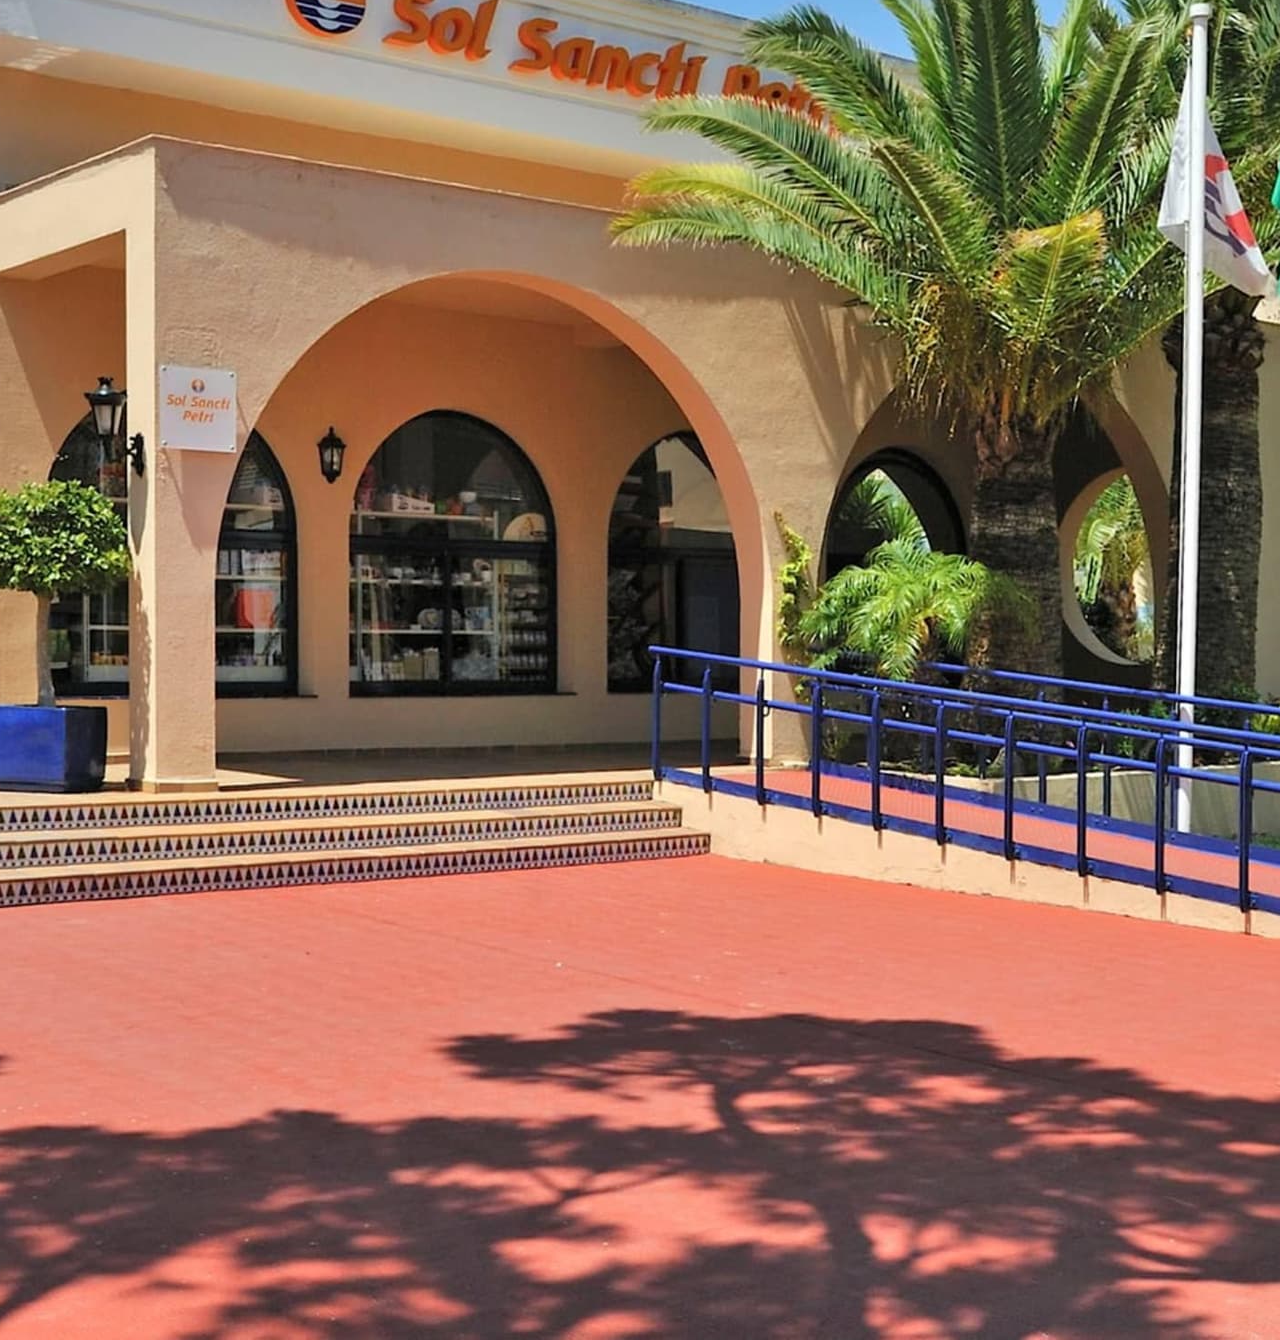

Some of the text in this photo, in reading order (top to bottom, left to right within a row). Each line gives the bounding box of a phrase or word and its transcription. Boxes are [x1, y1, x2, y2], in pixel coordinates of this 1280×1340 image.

[507, 17, 708, 100] Sancti
[166, 393, 231, 410] Sol Sancti
[183, 410, 214, 423] Petri
